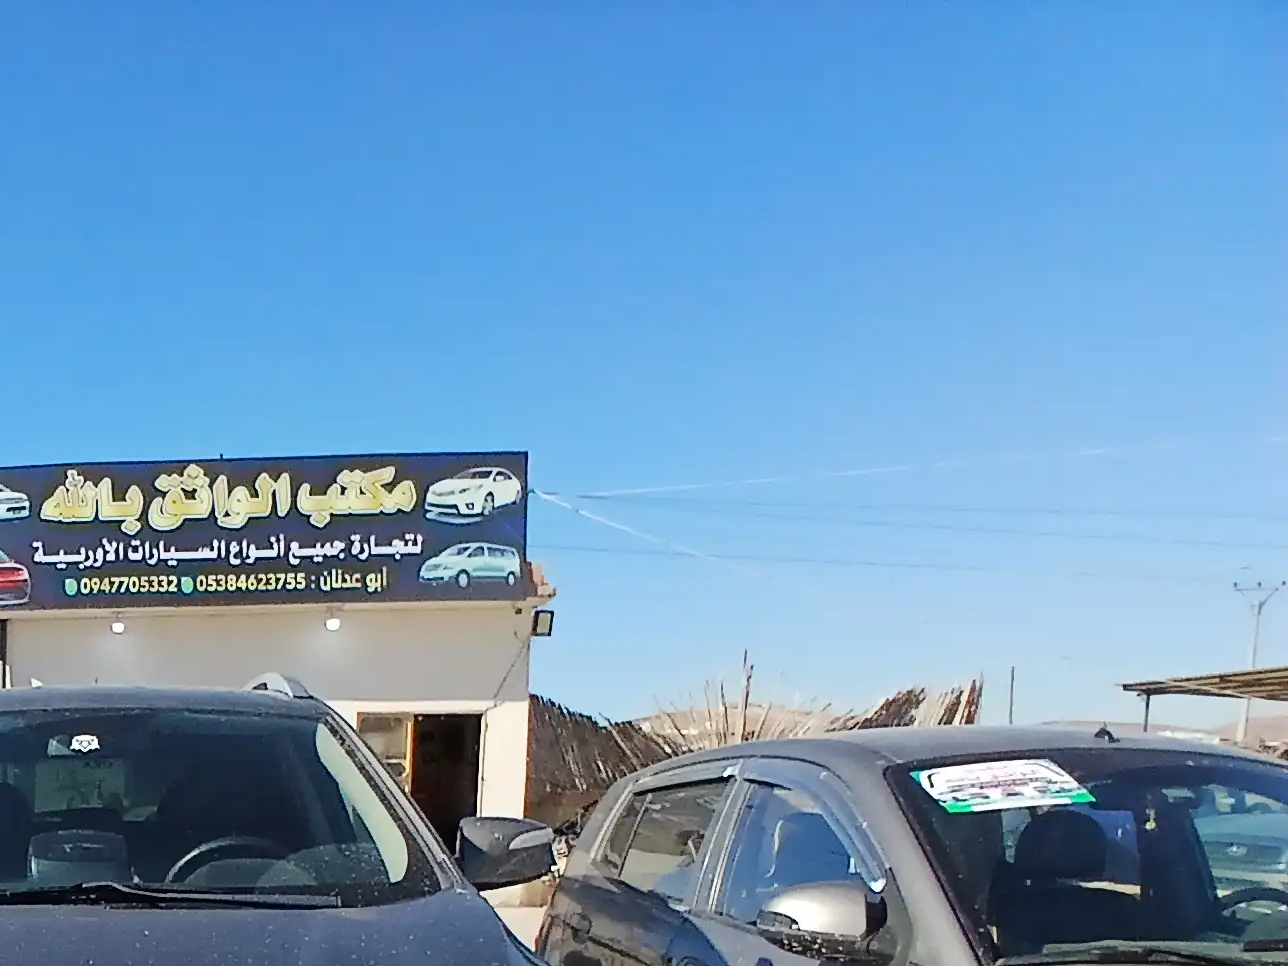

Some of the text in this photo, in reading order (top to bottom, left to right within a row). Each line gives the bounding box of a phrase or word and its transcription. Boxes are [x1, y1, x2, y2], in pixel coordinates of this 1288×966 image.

[40, 464, 417, 535] مكتب الواثق بالله
[127, 537, 226, 567] السيارات
[289, 541, 346, 565] جميع
[350, 533, 423, 560] لتجارة
[80, 575, 178, 594] 0947705332
[196, 572, 306, 593] 05384623755
[319, 568, 362, 591] عدنان
